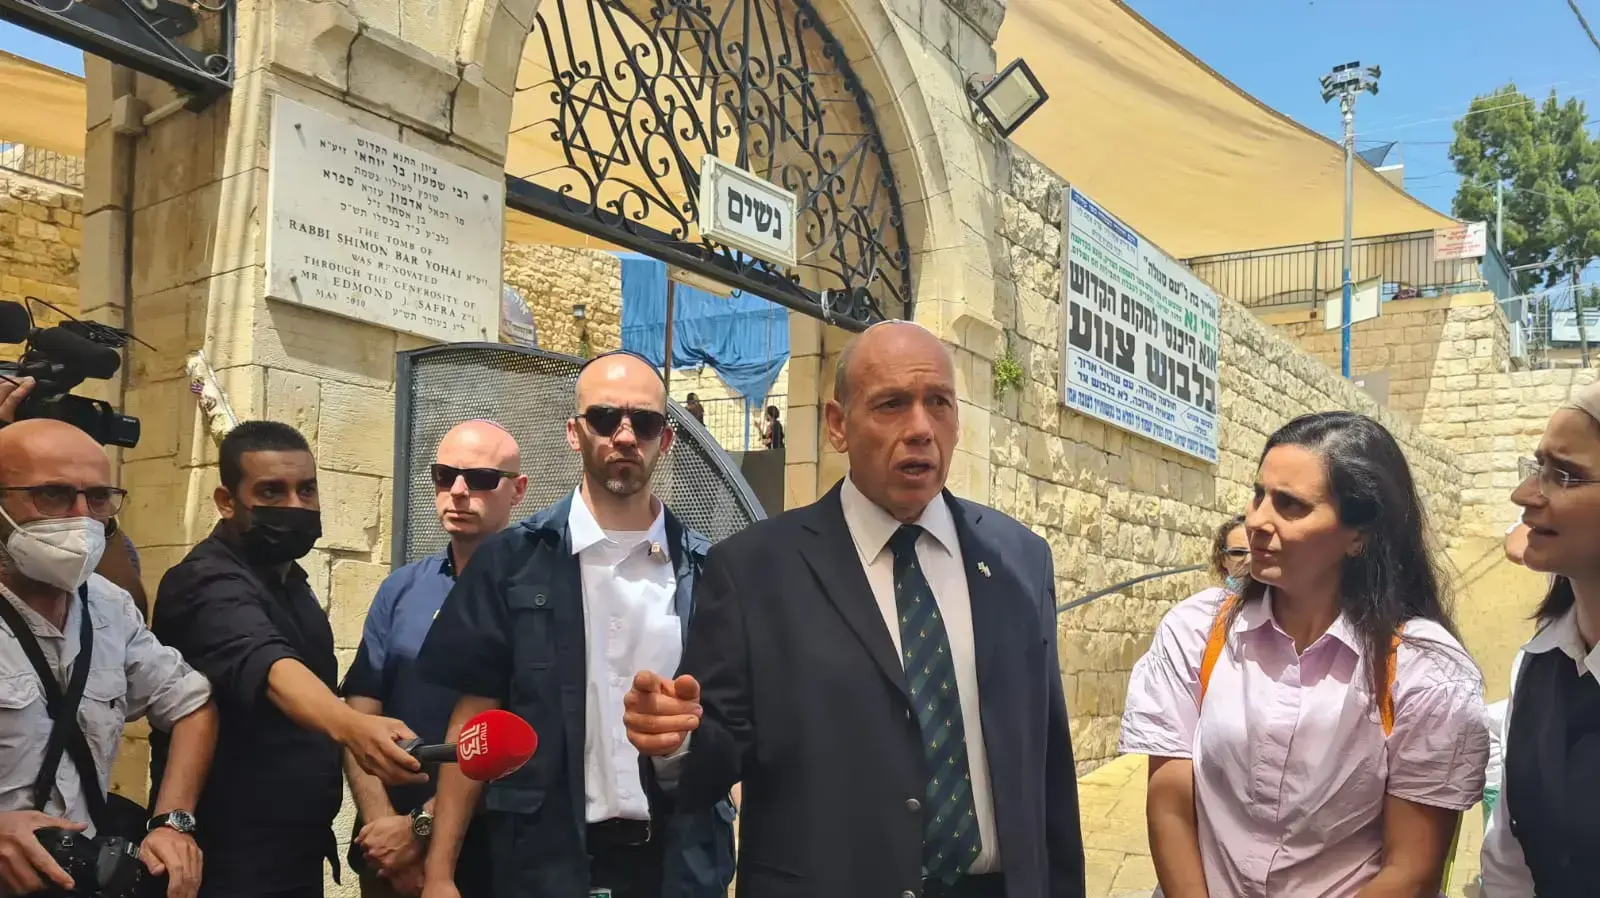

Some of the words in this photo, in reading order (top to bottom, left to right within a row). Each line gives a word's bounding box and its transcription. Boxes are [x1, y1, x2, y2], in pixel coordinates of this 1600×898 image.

[357, 137, 387, 157] הקדוש
[354, 150, 384, 169] יוחאי
[393, 151, 415, 166] התנא
[323, 168, 353, 187] ספרא
[354, 166, 378, 181] נשמת
[392, 164, 404, 177] בר
[421, 162, 437, 176] ציון
[361, 183, 383, 197] עזרא
[413, 171, 445, 194] שמעון
[391, 192, 421, 211] אדמון
[452, 186, 468, 200] רבי
[373, 211, 399, 228] בכסלו
[386, 204, 410, 219] אסתר
[417, 215, 425, 225] בן
[428, 204, 448, 220] רפאל
[455, 216, 464, 225] מר
[728, 186, 782, 240] נשים
[289, 219, 329, 239] RABBI
[337, 232, 387, 256] SHIMON
[395, 250, 418, 265] BAR
[425, 260, 461, 278] YOHAI
[358, 226, 378, 239] THE
[387, 235, 414, 250] TOMB
[420, 246, 432, 256] OF
[351, 253, 371, 265] WAS
[378, 261, 437, 284] RENOVATED
[304, 255, 360, 277] THROUGH
[368, 273, 388, 285] THE
[394, 280, 457, 304] GENEROSITY
[463, 300, 475, 309] OF
[1069, 258, 1115, 320] הקדוש
[315, 288, 336, 300] MAY
[345, 296, 365, 307] 2010
[333, 276, 392, 300] EDMOND
[418, 300, 455, 317] SAFRA
[1120, 288, 1157, 343] למקום
[1184, 307, 1196, 333] נא
[1069, 299, 1135, 374] צנוע
[1161, 316, 1195, 362] היכנסי
[1199, 341, 1215, 373] אנא
[1077, 369, 1088, 383] צר
[1099, 365, 1119, 384] שרוול
[1123, 377, 1133, 390] עם
[1145, 334, 1215, 415] בלבוש
[1091, 376, 1114, 395] בלבוש
[1117, 387, 1127, 401] לא
[1158, 394, 1176, 411] חולצה
[1155, 405, 1174, 422] חצאית
[460, 723, 481, 761] 13
